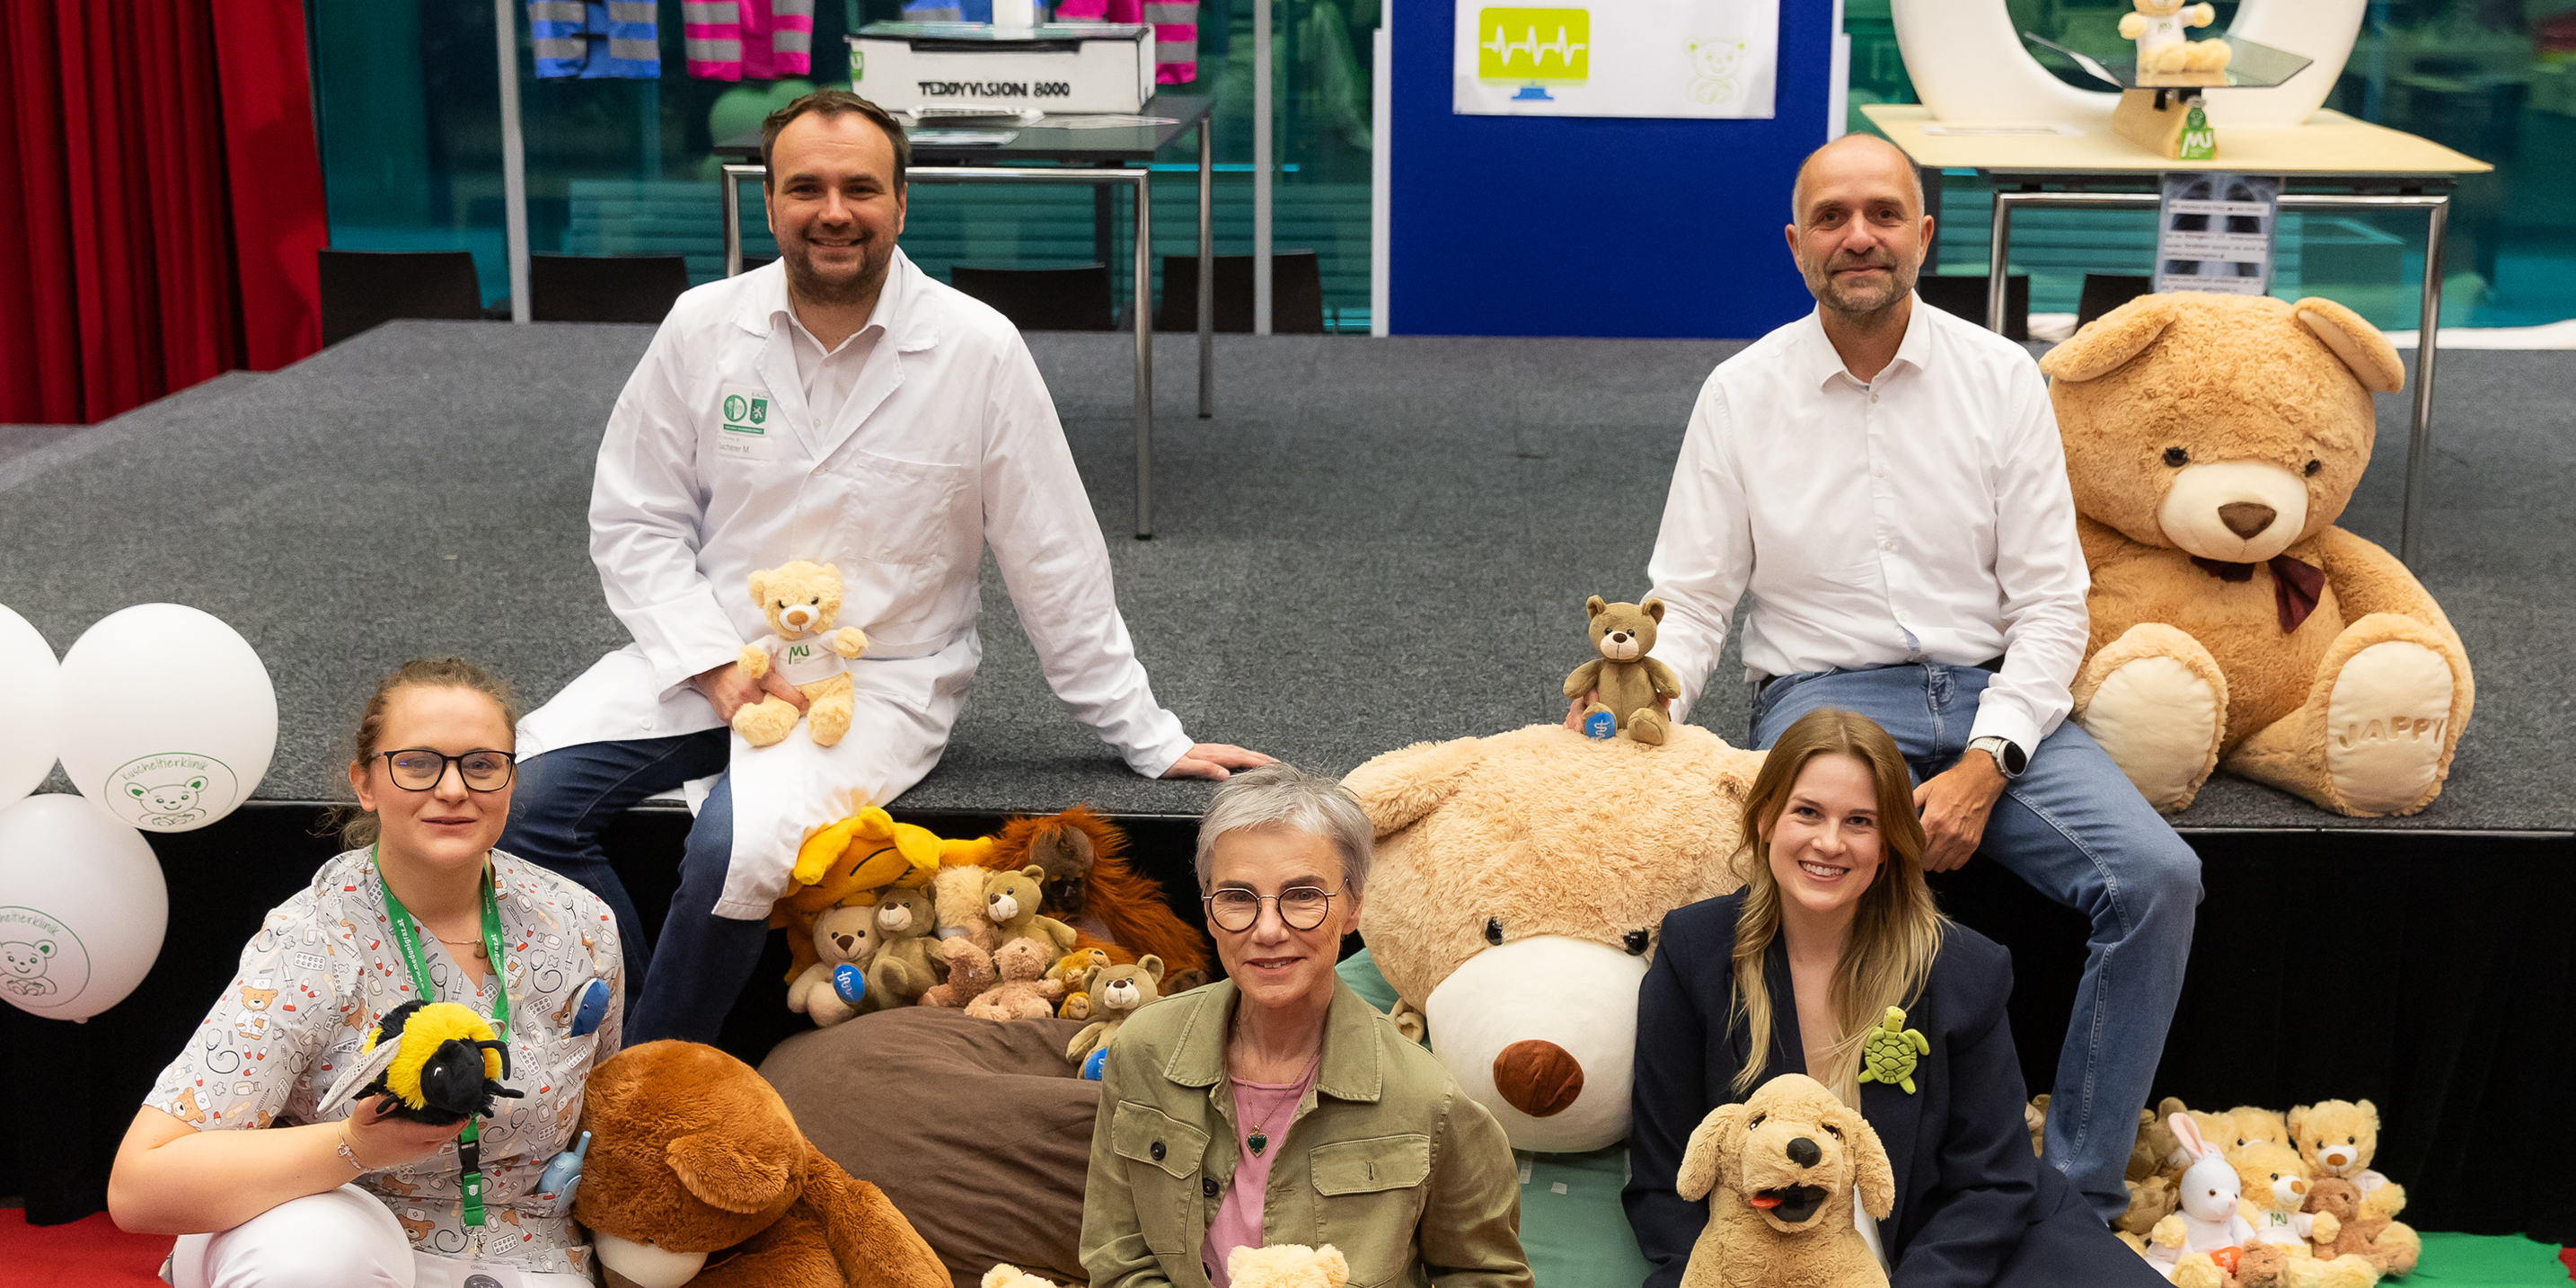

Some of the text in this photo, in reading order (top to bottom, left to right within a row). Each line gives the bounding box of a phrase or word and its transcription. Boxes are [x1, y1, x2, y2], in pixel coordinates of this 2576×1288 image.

[918, 82, 1071, 97] TEDDYVISION 8000
[2338, 716, 2445, 750] JAPPY
[397, 918, 426, 990] www.medunigraz.at
